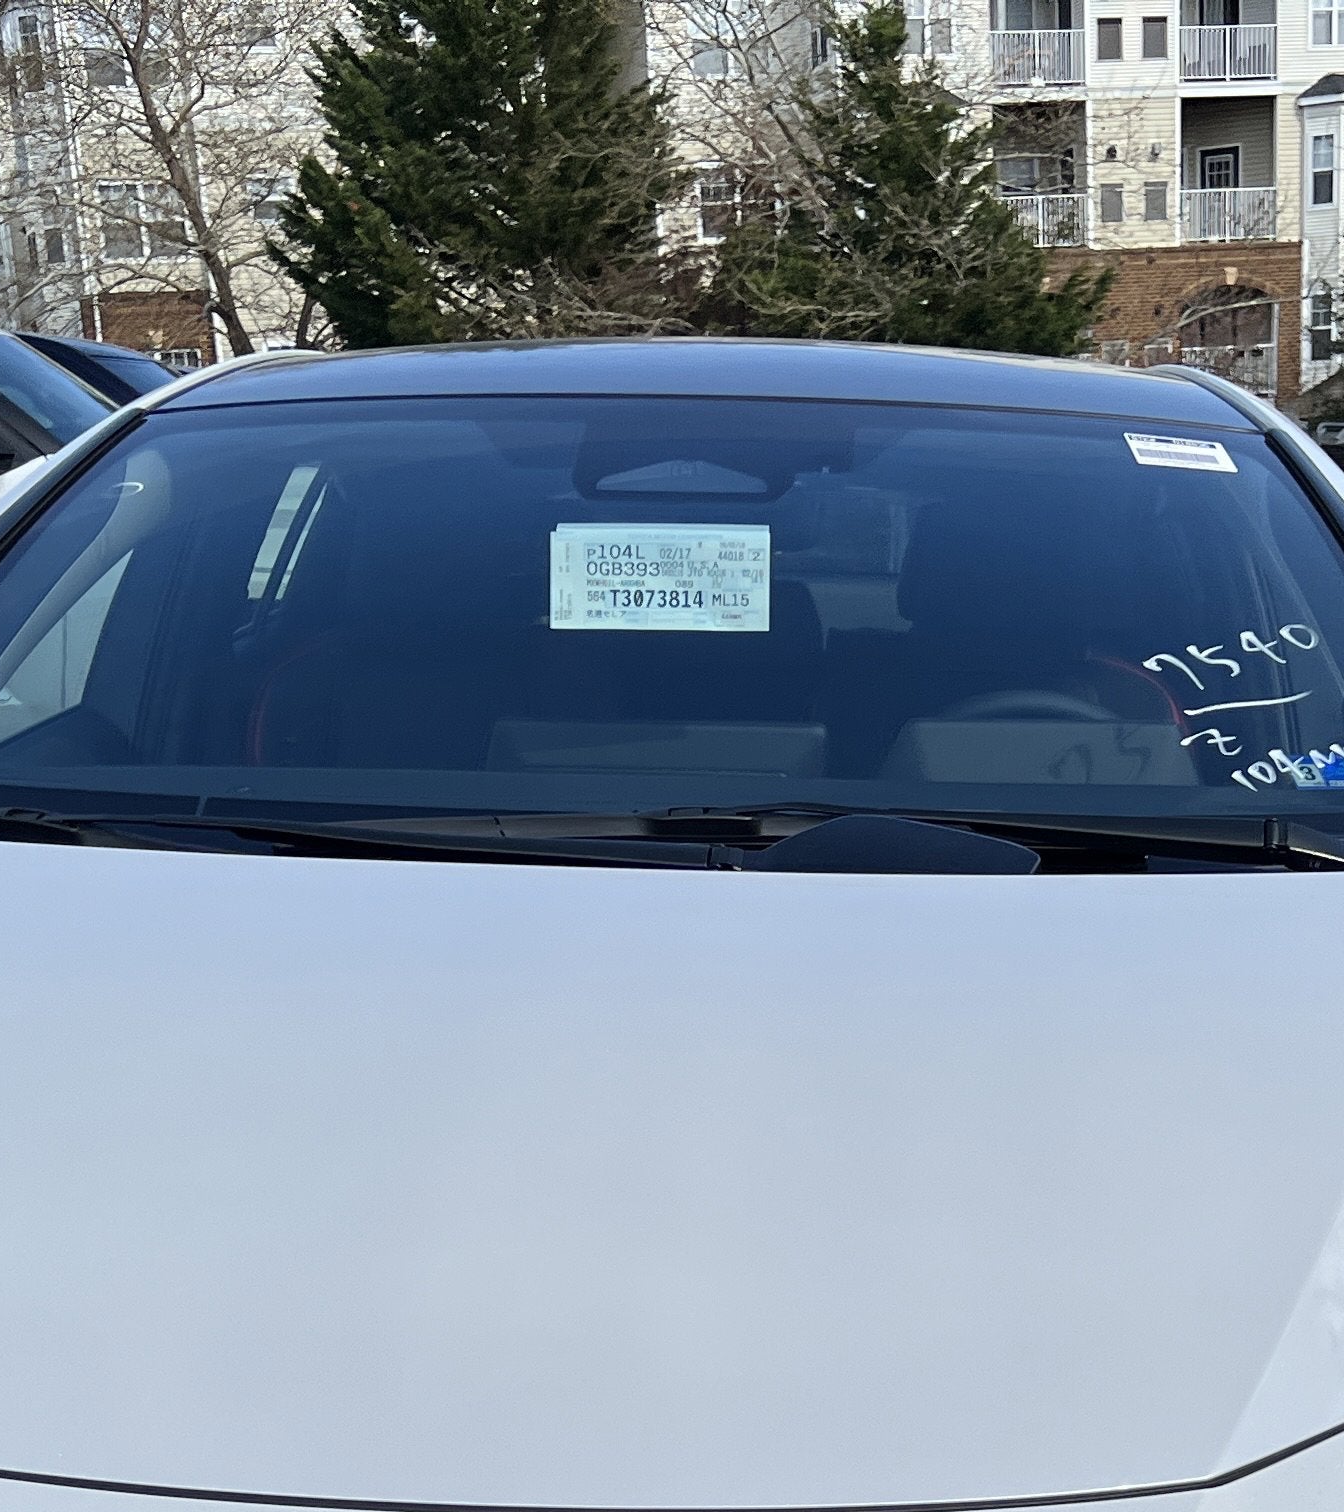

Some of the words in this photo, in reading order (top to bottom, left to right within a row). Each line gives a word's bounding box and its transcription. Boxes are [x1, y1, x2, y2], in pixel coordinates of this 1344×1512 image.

[751, 551, 761, 561] 2
[609, 589, 704, 609] T3073814
[711, 593, 750, 607] ML15
[1143, 623, 1320, 691] 7540
